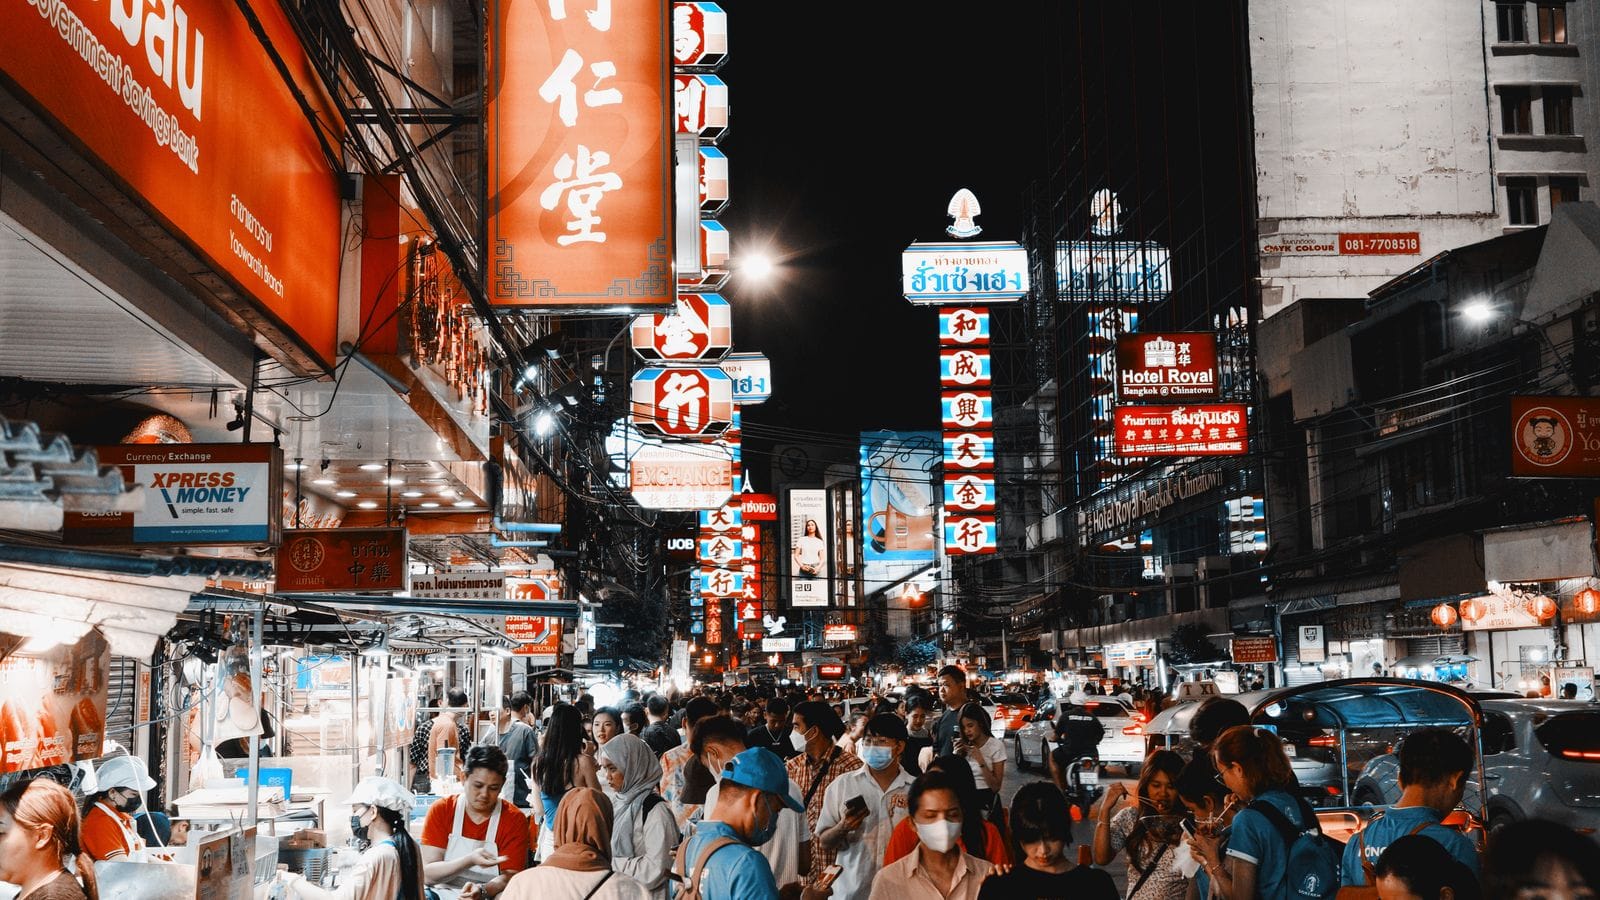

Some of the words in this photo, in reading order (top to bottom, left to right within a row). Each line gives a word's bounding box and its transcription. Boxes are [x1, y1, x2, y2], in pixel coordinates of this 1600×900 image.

[27, 0, 123, 96] overnment
[122, 64, 171, 147] Savings
[170, 114, 199, 175] Bank
[1263, 245, 1292, 253] CMYK
[1295, 244, 1335, 252] COLOUR
[1345, 238, 1419, 252] 081-7708518
[911, 260, 1022, 292] ฮั่วเซ่งเฮง
[1122, 368, 1164, 385] Hotel
[1167, 367, 1214, 387] Royal
[1123, 386, 1158, 397] Bangkok
[1160, 386, 1169, 396] @
[1170, 386, 1214, 395] Chinatown
[952, 313, 984, 547] 和成興大金行
[1208, 441, 1242, 451] MEDICINE
[126, 453, 167, 463] Currency
[168, 452, 212, 461] Exchange
[150, 472, 236, 488] XPRESS
[633, 466, 731, 486] EXCHANGE
[175, 487, 250, 503] MONEY
[1093, 507, 1115, 534] Hotel
[1116, 491, 1140, 527] Royal
[1139, 477, 1175, 518] Bangkok
[1178, 467, 1224, 500] Chinatown
[182, 507, 205, 515] simple.
[206, 506, 220, 514] fast.
[667, 538, 694, 550] UOB
[1183, 684, 1215, 696] TXI
